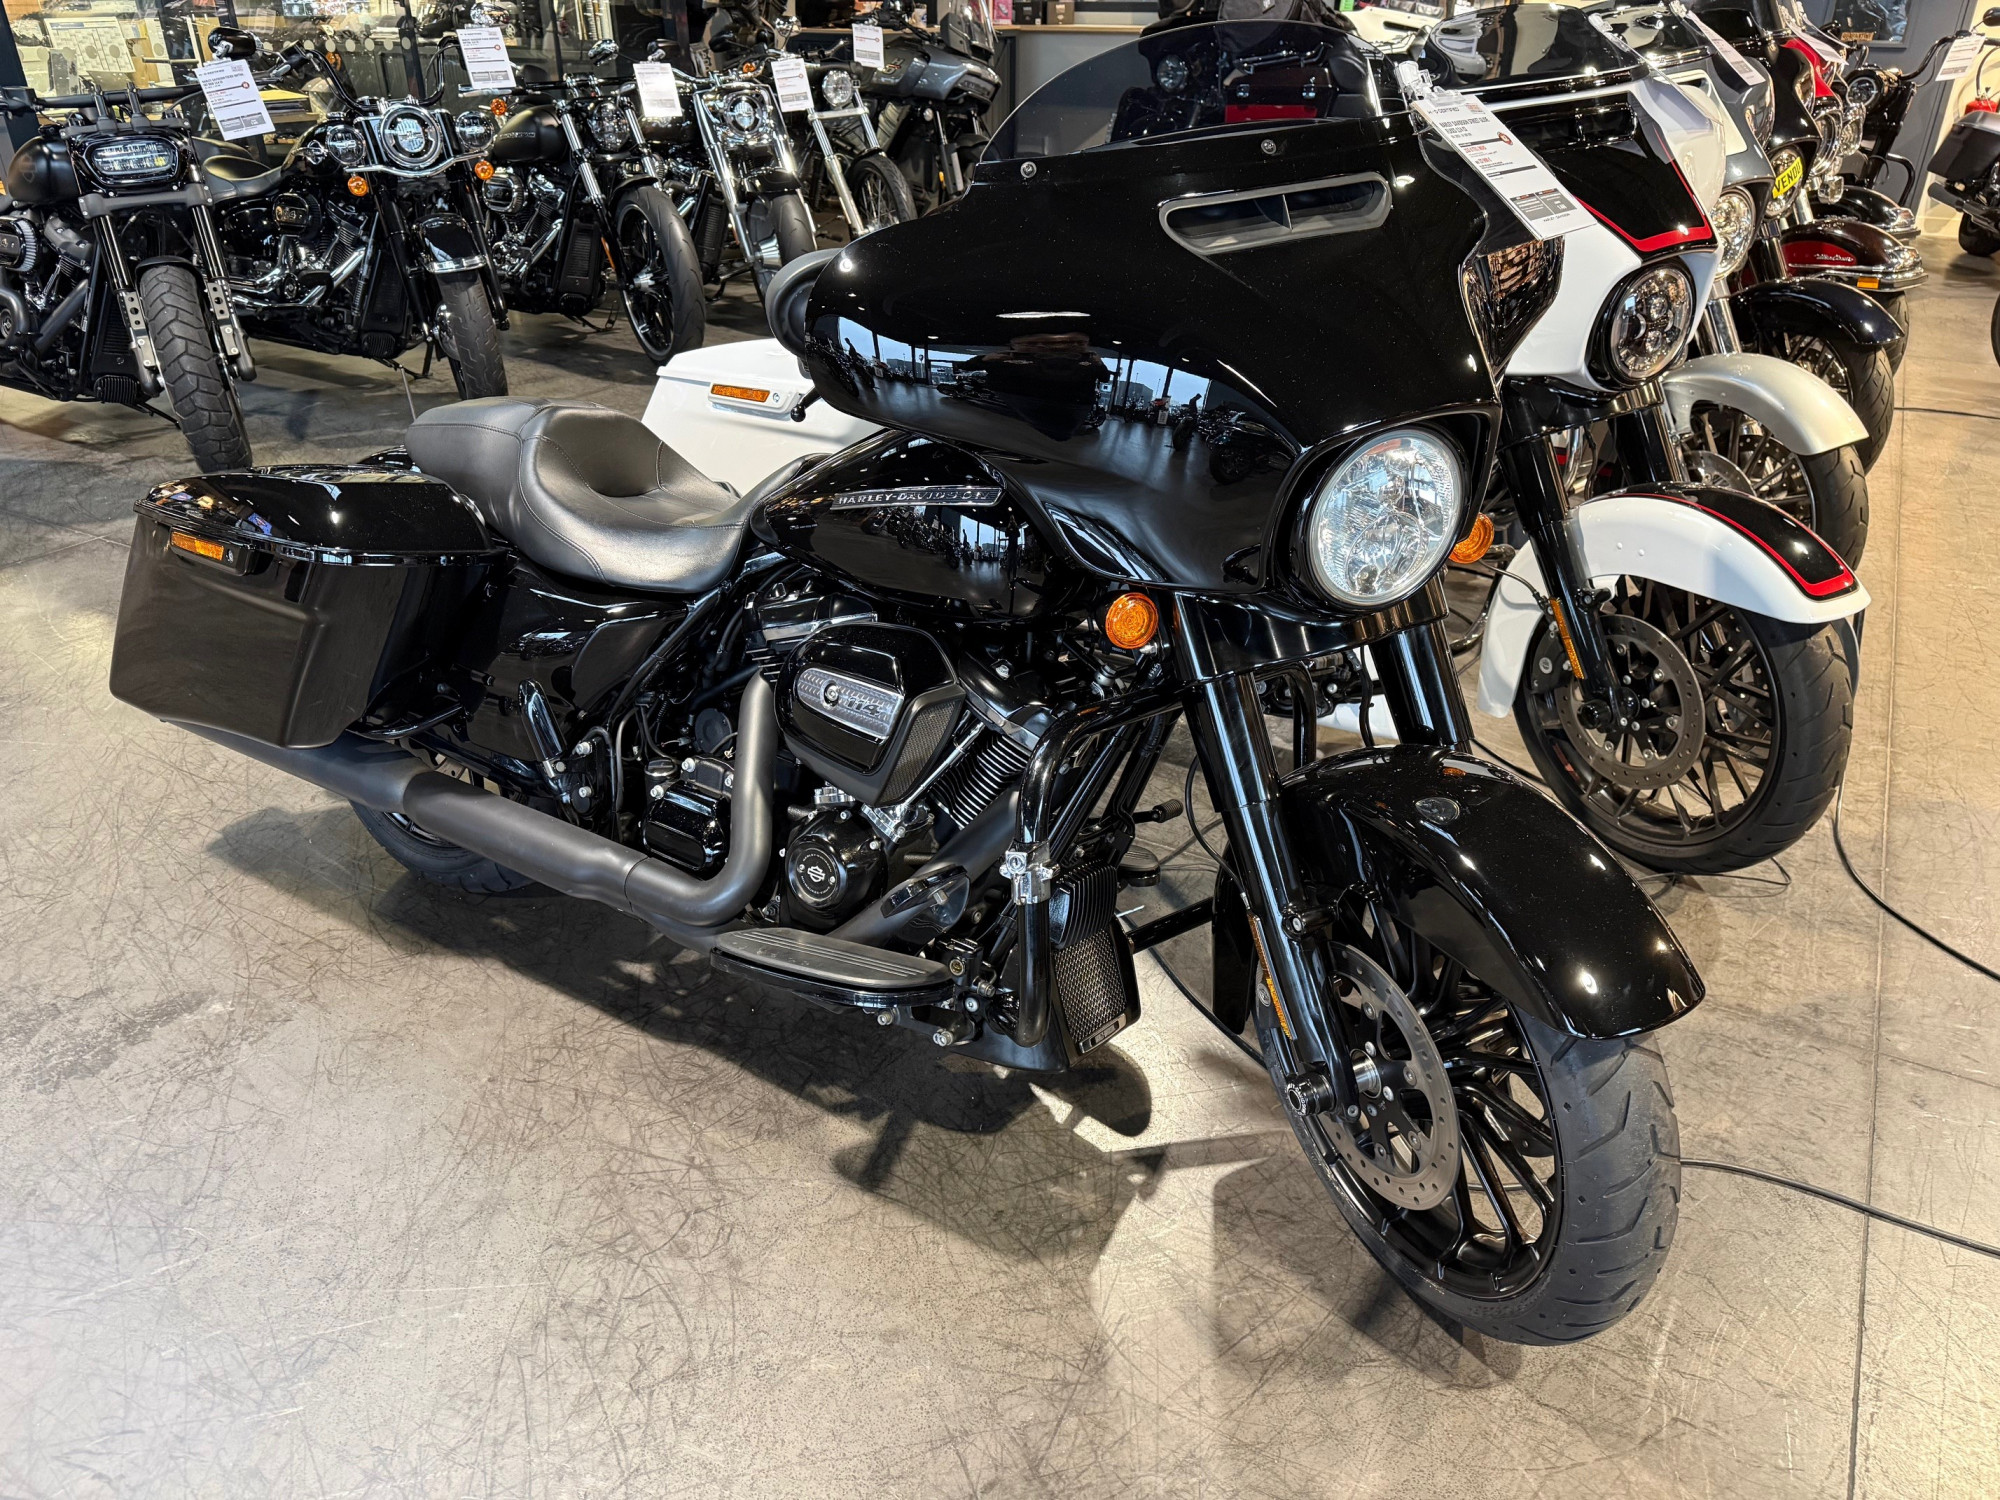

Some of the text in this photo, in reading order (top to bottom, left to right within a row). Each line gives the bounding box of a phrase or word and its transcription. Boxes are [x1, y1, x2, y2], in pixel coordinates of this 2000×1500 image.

[1774, 161, 1802, 192] VENDU
[838, 490, 991, 505] HARLEY-DAVIDSON
[847, 696, 881, 717] 114
